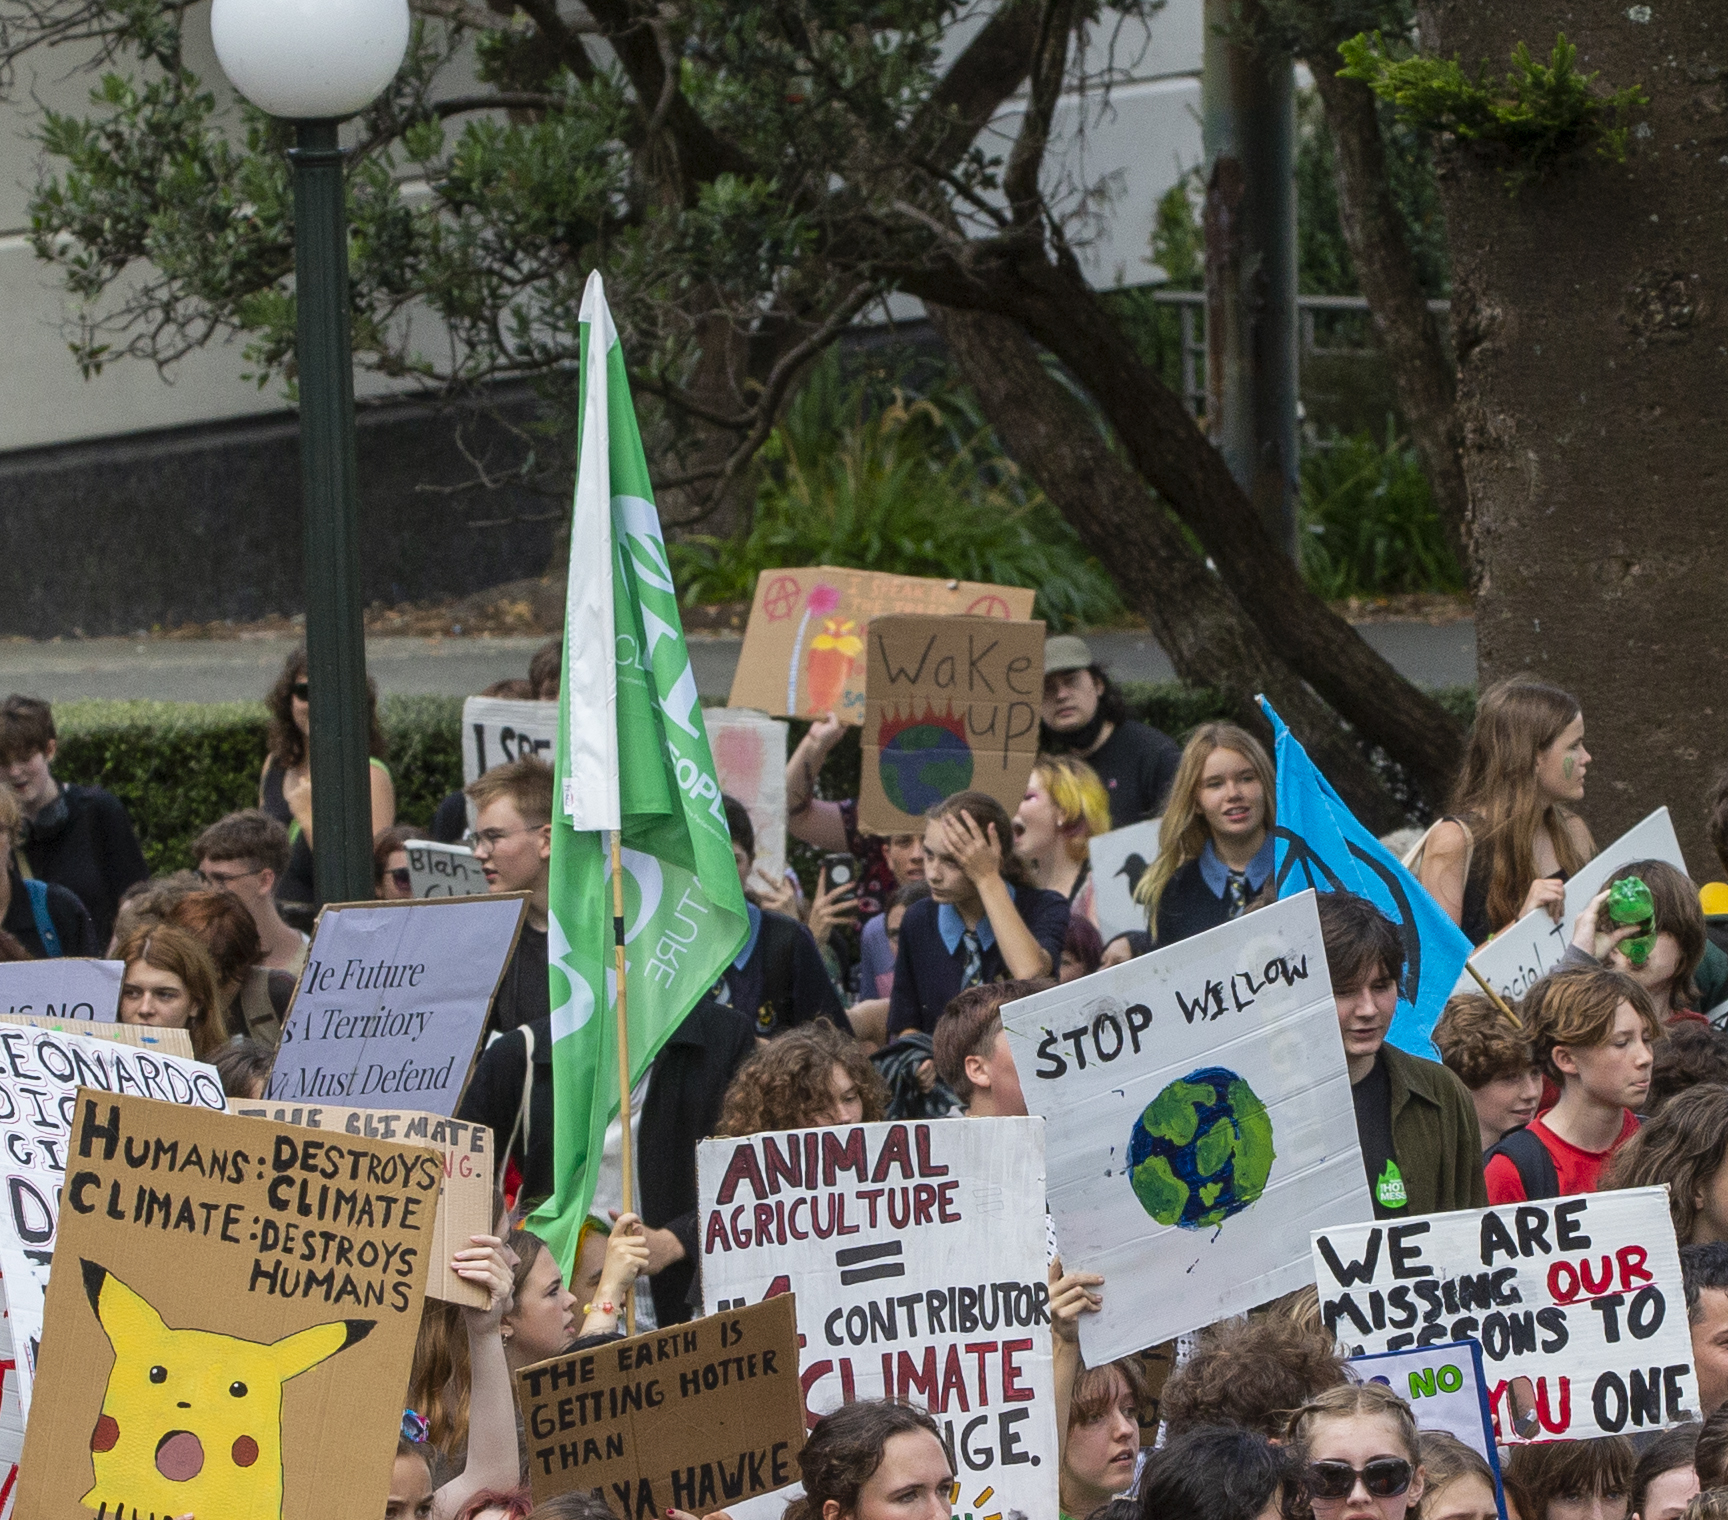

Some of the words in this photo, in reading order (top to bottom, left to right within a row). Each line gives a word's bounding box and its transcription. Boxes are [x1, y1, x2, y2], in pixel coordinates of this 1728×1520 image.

[340, 959, 425, 991] Future
[322, 1006, 434, 1042] Territory
[1035, 1003, 1153, 1079] STOP
[1175, 954, 1309, 1025] WILLOW
[292, 1066, 358, 1099] Must
[361, 1056, 455, 1096] Defend
[272, 1134, 441, 1192] DESTROYS
[345, 1112, 487, 1153] CLIMATE
[716, 1124, 949, 1205] ANIMAL
[268, 1175, 422, 1231] CLIMATE
[705, 1180, 962, 1255] AGRICULTURE
[262, 1218, 419, 1277] DESTROYS
[1316, 1221, 1434, 1288] WE
[1480, 1198, 1592, 1267] ARE
[248, 1258, 412, 1313] HUMANS
[824, 1281, 1052, 1346] CONTRIBUTOR
[1323, 1266, 1524, 1336] MISSING
[1547, 1245, 1653, 1302] OUR
[1352, 1307, 1569, 1362] ESSONS
[1591, 1285, 1666, 1344] TO
[522, 1355, 595, 1398] THE
[617, 1330, 698, 1373] EARTH
[720, 1318, 744, 1349] IS
[801, 1338, 1035, 1432] CLIMATE
[1408, 1363, 1463, 1399] NO
[530, 1379, 666, 1440] GETTING
[679, 1349, 779, 1399] HOTTER
[1592, 1363, 1692, 1434] ONE
[536, 1432, 625, 1475] THAN
[670, 1441, 790, 1512] HAWKE
